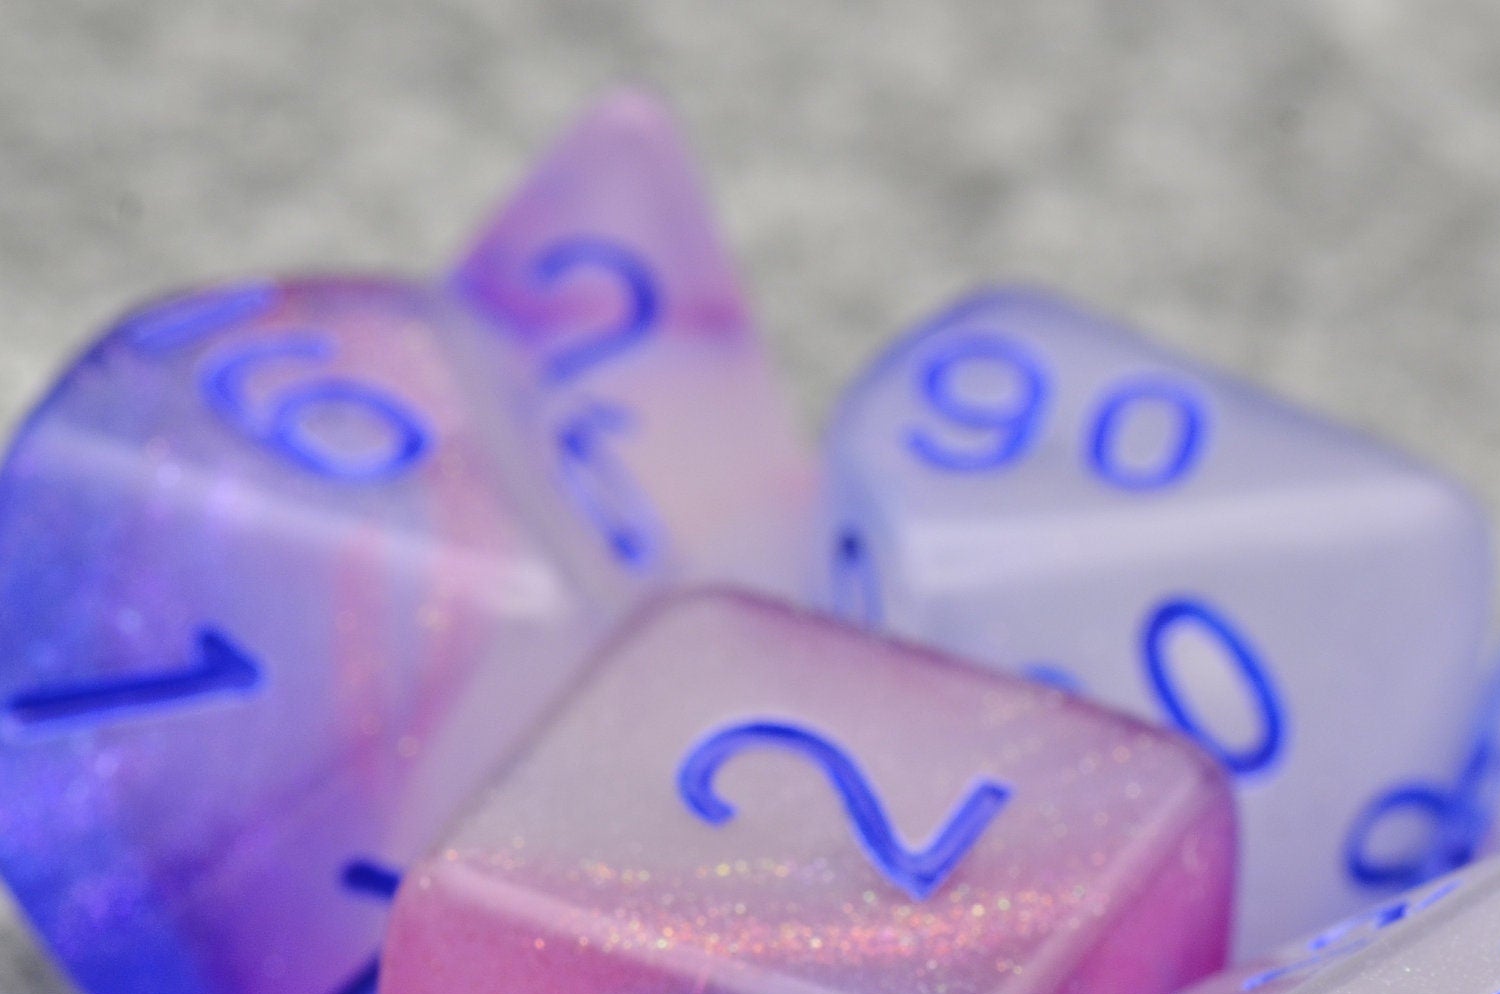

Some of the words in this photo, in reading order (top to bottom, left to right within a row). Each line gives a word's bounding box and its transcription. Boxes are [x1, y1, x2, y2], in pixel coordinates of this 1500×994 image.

[903, 332, 1213, 492] 90
[3, 626, 267, 732] 1
[674, 717, 1015, 900] 2
